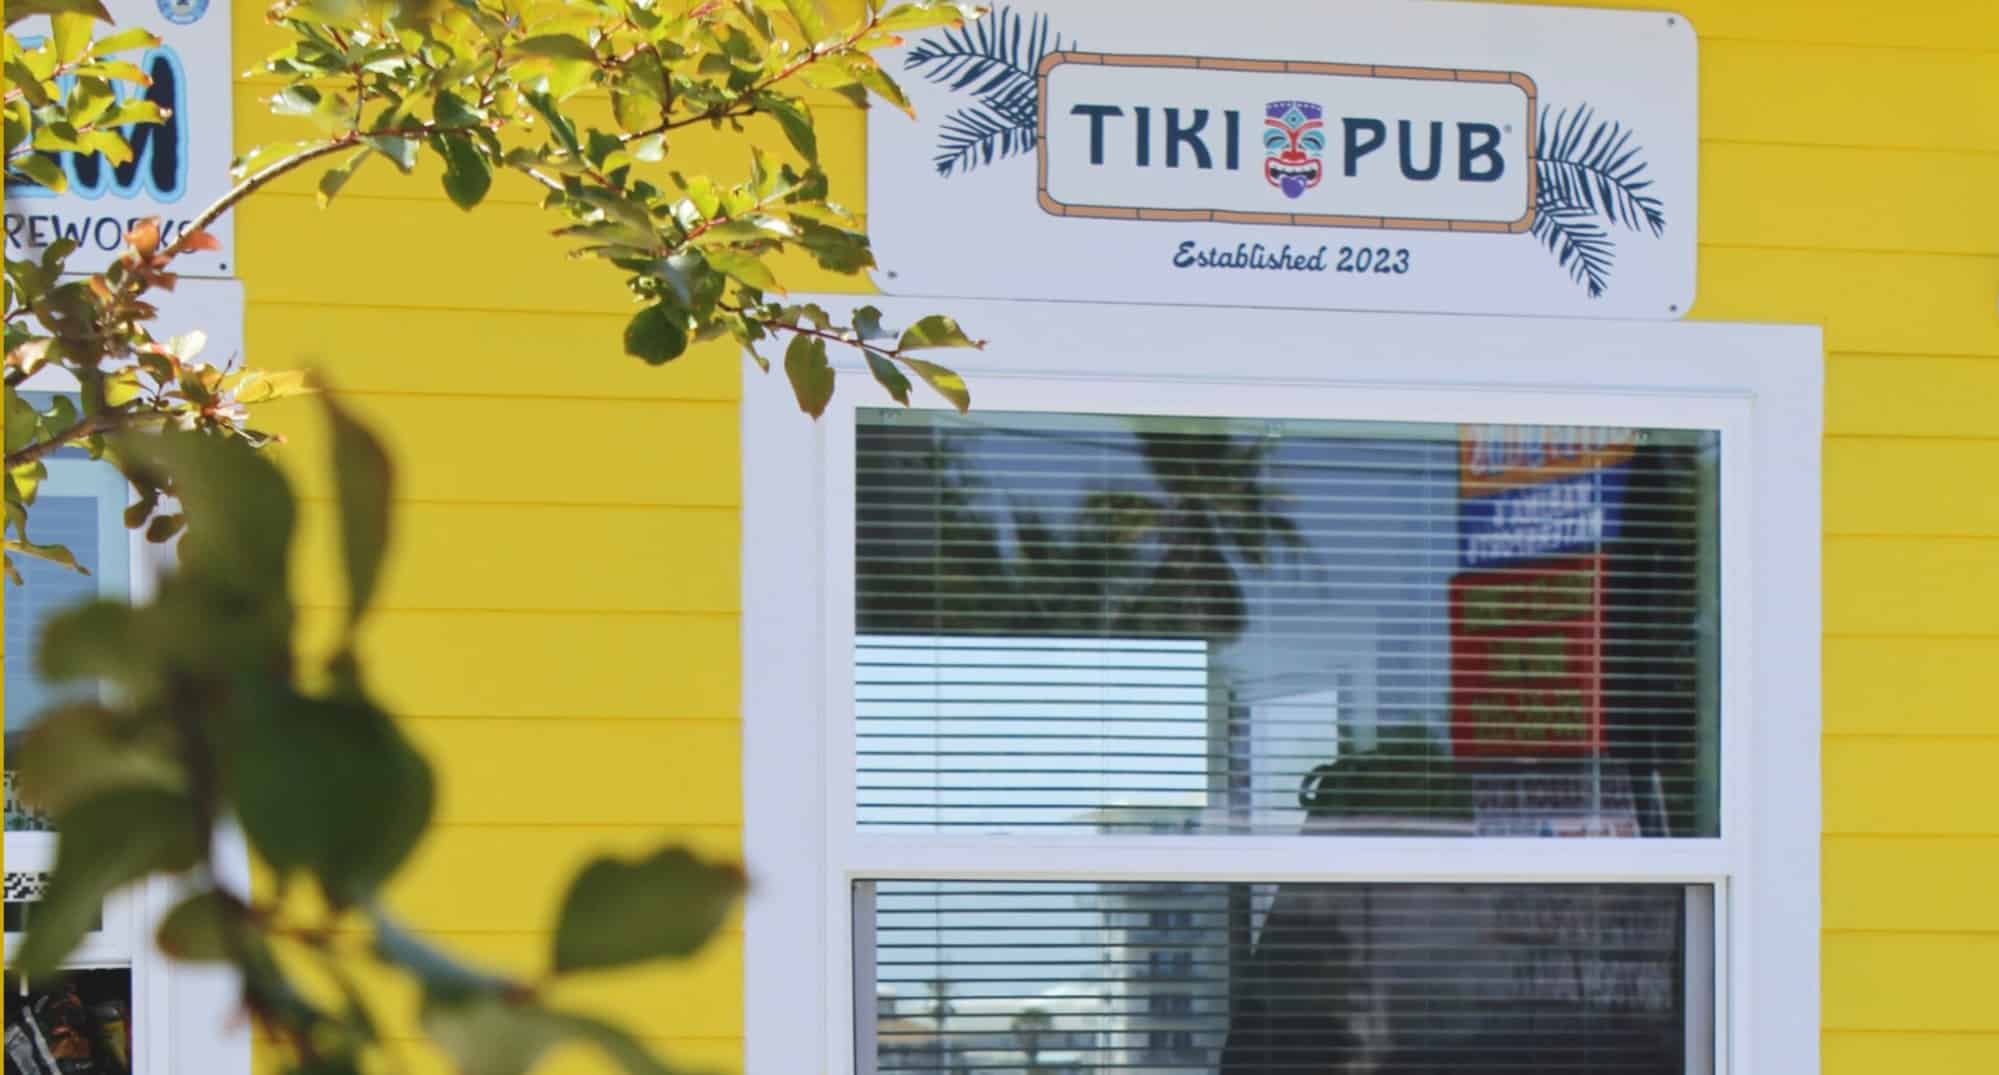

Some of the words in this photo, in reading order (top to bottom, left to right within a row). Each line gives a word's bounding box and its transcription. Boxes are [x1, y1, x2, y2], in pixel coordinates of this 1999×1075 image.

[1070, 104, 1240, 170] TIKI
[1341, 117, 1505, 182] PUB
[4, 213, 198, 255] REWOK
[1172, 240, 1328, 272] Established
[1335, 246, 1411, 274] 2023
